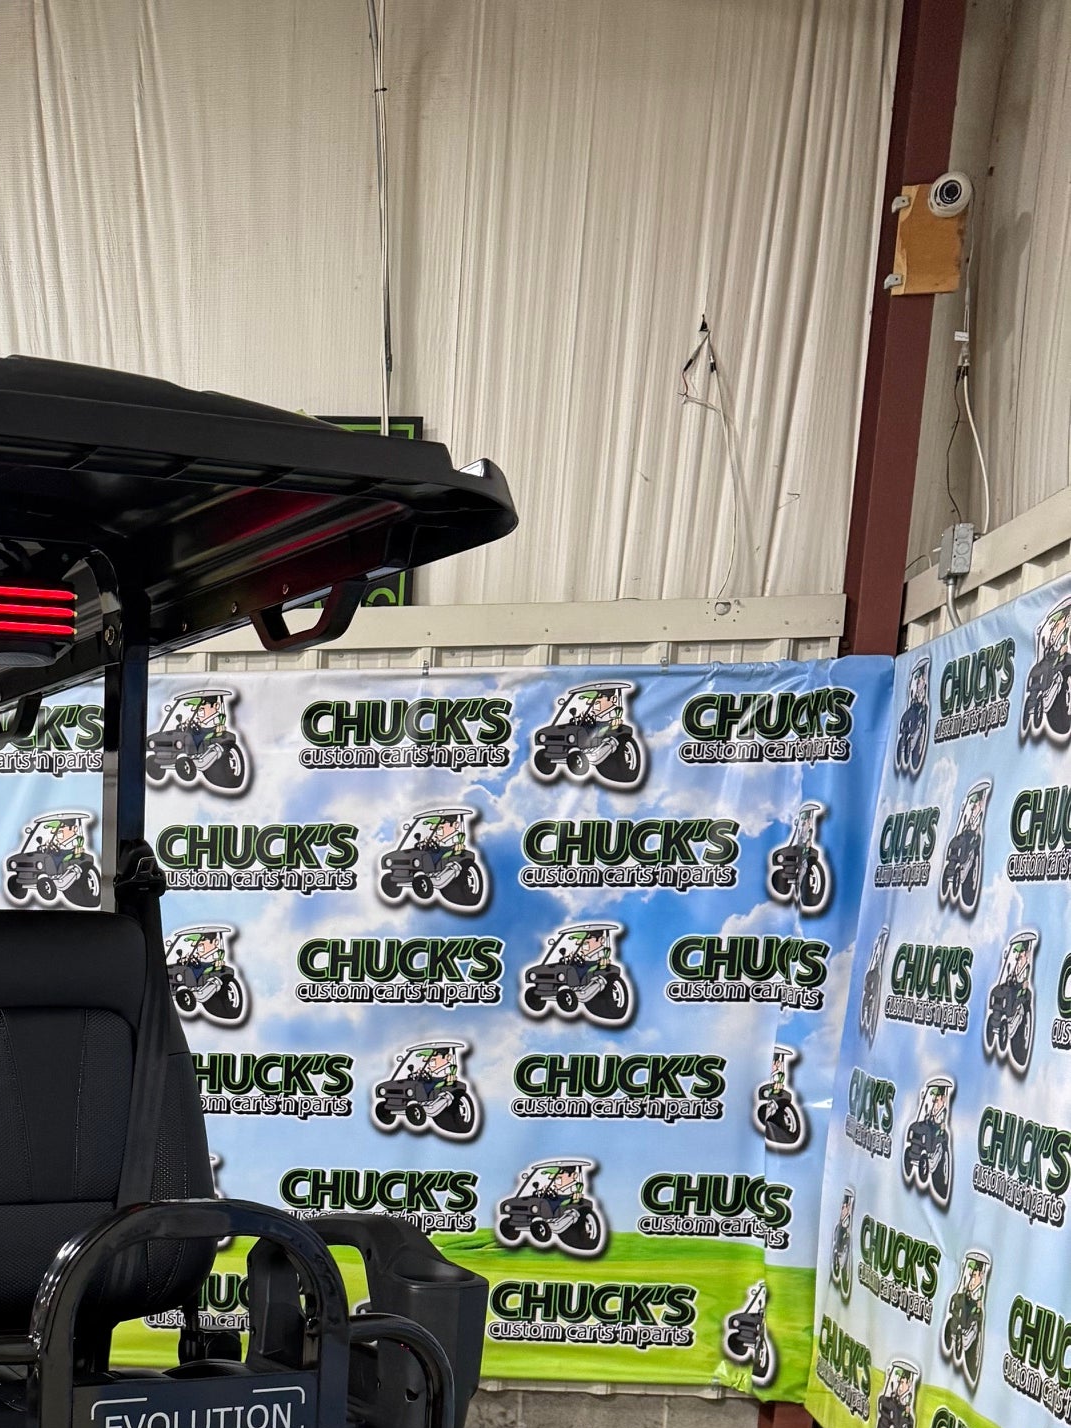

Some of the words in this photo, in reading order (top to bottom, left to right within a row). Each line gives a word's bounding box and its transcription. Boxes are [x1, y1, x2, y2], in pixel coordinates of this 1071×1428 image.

[939, 637, 1015, 717] CHUCK'S
[301, 698, 512, 746] CHUCK'S
[52, 751, 104, 776] parts
[299, 746, 377, 767] custom
[379, 744, 429, 767] carts
[451, 746, 507, 771] parts
[680, 740, 762, 762] custom
[156, 824, 359, 869] CHUCK'S
[524, 819, 739, 866] CHUCK'S
[167, 869, 231, 890] ustom
[232, 868, 278, 890] carts
[301, 869, 356, 894] parts
[521, 866, 600, 887] custom
[602, 864, 653, 887] carts
[675, 866, 734, 891] parts
[297, 938, 503, 982] CHUCK'S
[891, 943, 973, 1004] CHUCK'S
[295, 982, 372, 1002] custom
[373, 981, 420, 1003] carts
[443, 983, 499, 1007] parts
[666, 980, 749, 1002] custom
[191, 1053, 354, 1096] HUCK'S
[513, 1054, 727, 1098] CHUCK'S
[230, 1094, 277, 1114] carts
[298, 1095, 352, 1120] parts
[511, 1096, 589, 1118] custom
[591, 1096, 641, 1118] carts
[664, 1098, 723, 1123] parts
[978, 1106, 1071, 1196] CHUCK'S
[280, 1167, 478, 1212] CHUCK'S
[1030, 1189, 1066, 1228] parts
[422, 1210, 476, 1235] parts
[638, 1215, 719, 1237] custom
[860, 1215, 941, 1300] CHUCK'S
[490, 1281, 697, 1327] CHUCK'S
[488, 1322, 566, 1344] custom
[566, 1323, 614, 1346] carts
[636, 1325, 693, 1350] parts
